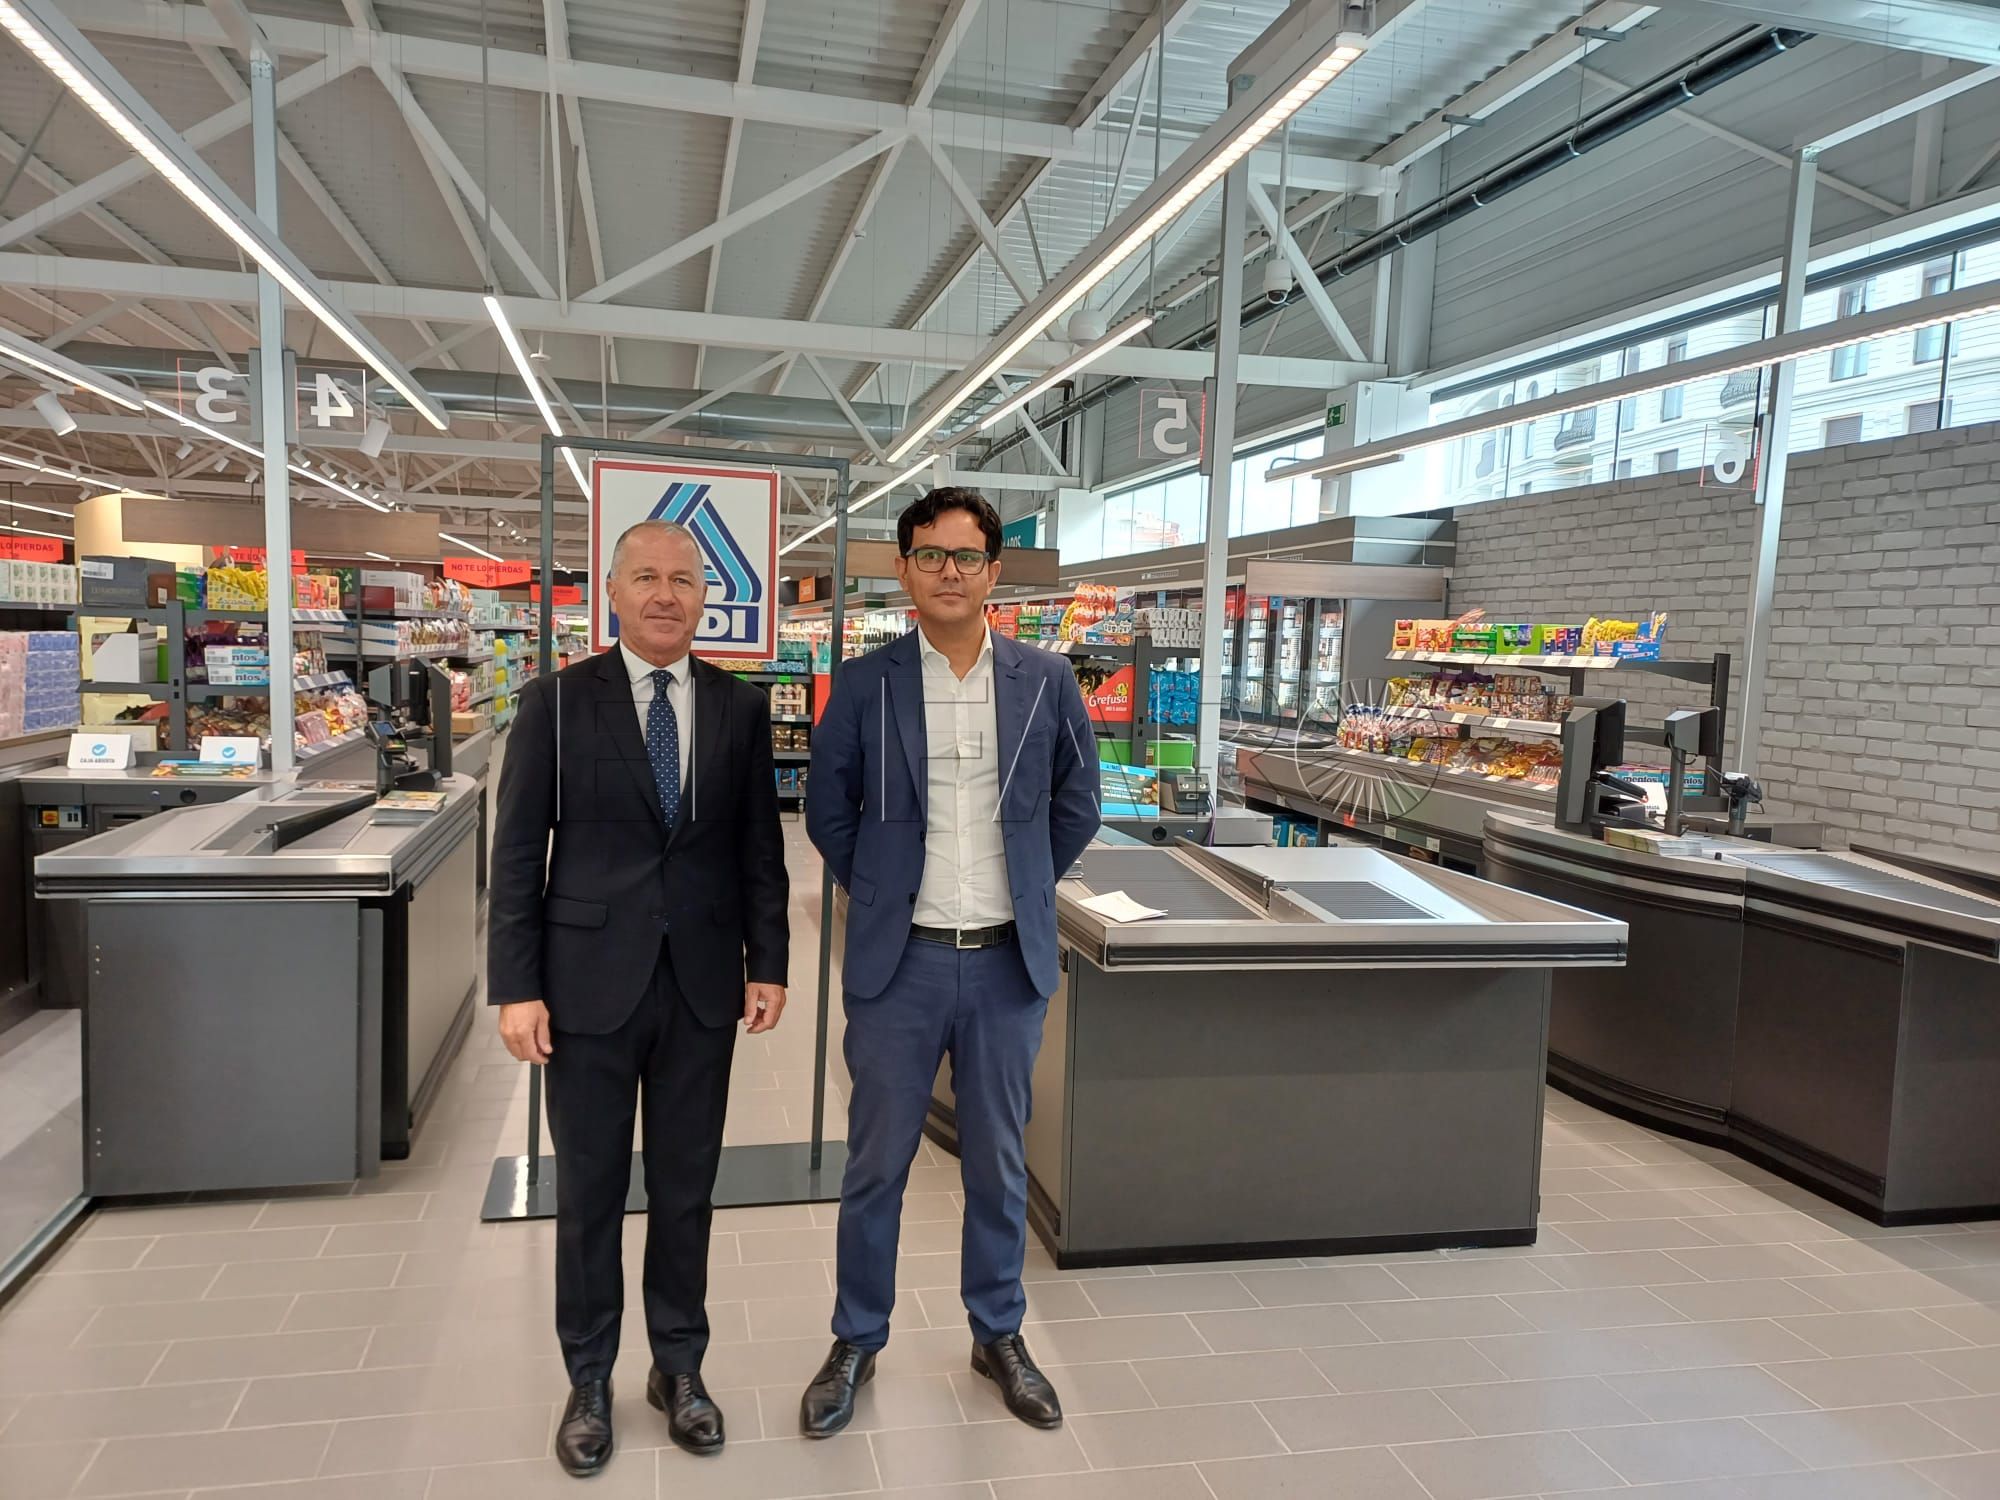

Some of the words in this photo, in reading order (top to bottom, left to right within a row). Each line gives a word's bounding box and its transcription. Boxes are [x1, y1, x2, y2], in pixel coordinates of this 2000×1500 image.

[14, 543, 55, 552] PIERDAS
[451, 563, 463, 572] NO
[464, 564, 475, 572] TE
[476, 564, 487, 572] LO
[488, 565, 523, 574] PIERDAS
[1088, 694, 1128, 708] Grefusa
